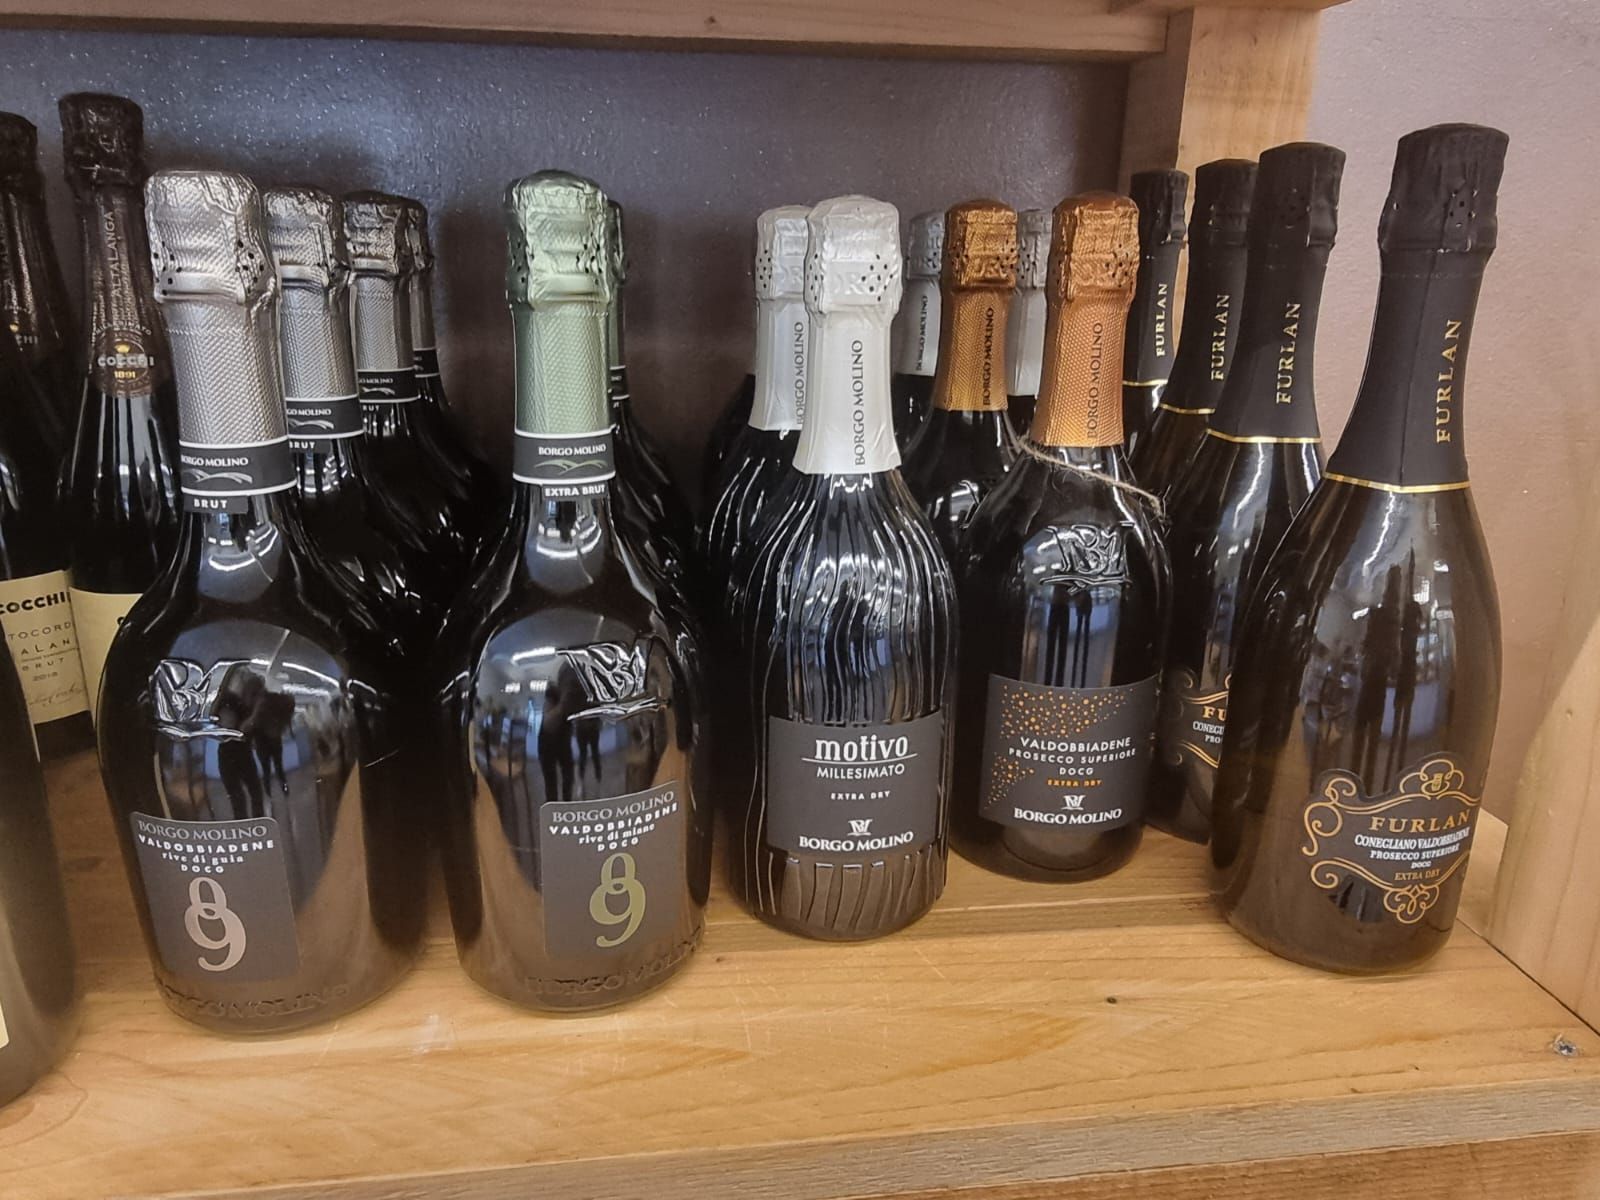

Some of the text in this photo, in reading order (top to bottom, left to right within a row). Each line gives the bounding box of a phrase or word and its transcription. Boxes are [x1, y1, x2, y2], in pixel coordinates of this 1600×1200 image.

[1155, 283, 1168, 357] FURLAN
[983, 307, 994, 360] MOLINO
[1211, 294, 1230, 380] FURLAN
[794, 321, 805, 377] MOLINO
[1090, 322, 1103, 384] MOLINO
[1276, 302, 1301, 404] FURLAN
[1436, 319, 1462, 443] FURLAN
[298, 408, 332, 416] MOLINO
[851, 339, 866, 466] BORGO MOLINO
[538, 443, 606, 456] BORGO MOLINO
[205, 457, 249, 467] MOLINO
[545, 484, 605, 497] EXTRA BRUT
[193, 498, 228, 509] BRUT
[8, 620, 72, 641] TOCORD
[814, 733, 909, 762] motivo
[1020, 736, 1131, 752] VALDOBBIADENE
[1008, 747, 1136, 765] PROSECCO SUPERIORE
[816, 763, 905, 779] MILLESIMATO
[830, 790, 890, 801] EXTRA DRY
[552, 791, 674, 823] BORGO MOLINO
[1013, 807, 1122, 825] BORGO MOLINO
[549, 802, 678, 836] VALDOBBIADENE
[1369, 809, 1470, 833] FURLAN
[138, 820, 268, 841] BORGO MOLINO
[607, 831, 619, 841] di
[138, 834, 274, 854] VALDOBBIADENE
[799, 831, 914, 852] BORGO MOLINO
[1354, 834, 1417, 850] CONEGLIANO
[1370, 842, 1460, 860] PROSECCO SUPERIORE
[162, 851, 187, 862] rive
[192, 854, 206, 864] di
[1394, 869, 1440, 881] EXTRA DRY
